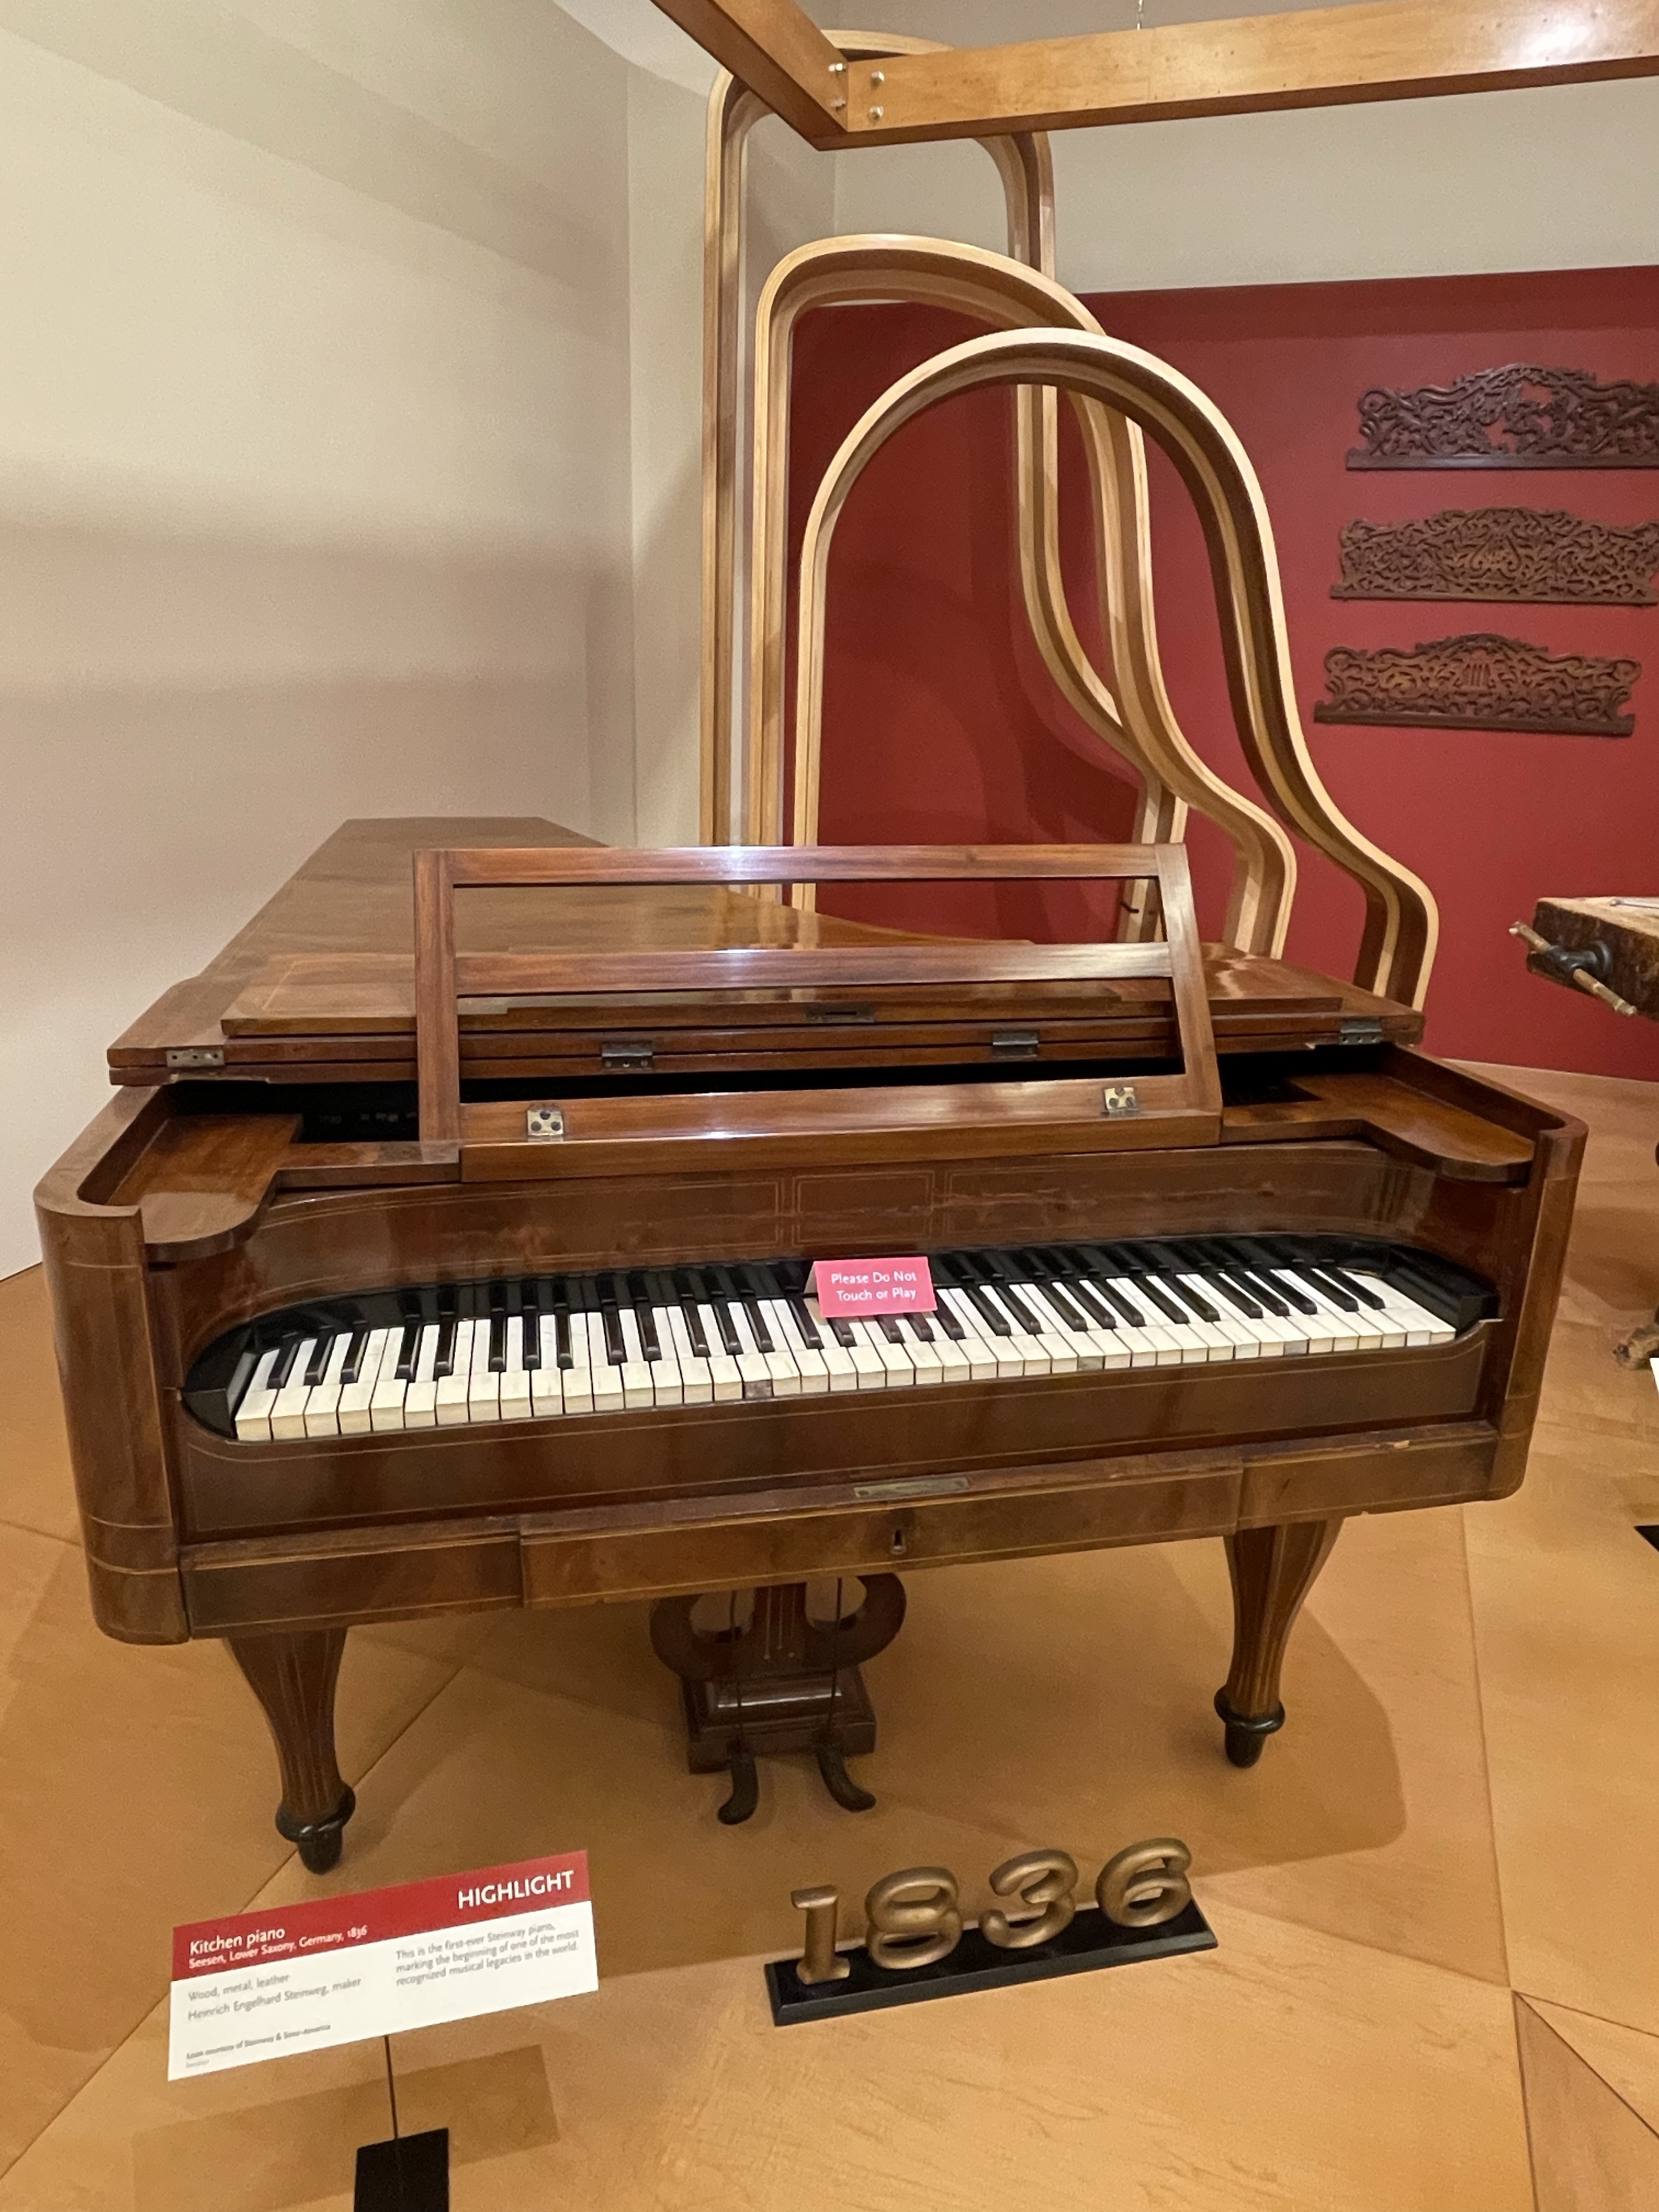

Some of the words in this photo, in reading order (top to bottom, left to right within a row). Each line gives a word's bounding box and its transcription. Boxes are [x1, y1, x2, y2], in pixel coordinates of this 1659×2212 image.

[831, 1273, 869, 1284] Please
[872, 1272, 890, 1283] Do
[893, 1271, 917, 1282] Not
[836, 1290, 872, 1301] Touch
[876, 1290, 888, 1300] or
[892, 1287, 916, 1300] Play
[458, 1870, 574, 1909] HIGHLIGHT
[791, 1837, 1192, 1985] 1836
[189, 1954, 227, 1970] Seesen,
[229, 1948, 259, 1962] Lower
[261, 1941, 297, 1955] Saxony,
[298, 1932, 345, 1948] Germany,
[347, 1925, 369, 1940] 1836
[190, 1935, 242, 1955] Kitchen
[247, 1928, 286, 1949] piano
[396, 1949, 415, 1960] This
[417, 1948, 426, 1956] is
[428, 1943, 443, 1954] the
[445, 1937, 485, 1950] first-ever
[487, 1929, 526, 1943] Steinway
[528, 1923, 556, 1936] piano,
[396, 1960, 433, 1973] marking
[436, 1954, 450, 1966] the
[452, 1946, 497, 1963] beginning
[499, 1941, 509, 1953] of
[510, 1941, 527, 1951] one
[529, 1934, 539, 1946] of
[540, 1934, 554, 1944] the
[556, 1929, 579, 1941] most
[396, 1967, 447, 1986] recognized
[449, 1959, 484, 1974] musical
[486, 1954, 522, 1970] legacies
[524, 1951, 533, 1960] in
[535, 1947, 550, 1958] the
[552, 1940, 579, 1955] world.
[188, 1987, 221, 2002] Wood,
[223, 1979, 254, 1995] metal,
[256, 1974, 290, 1988] leather
[188, 2003, 230, 2021] Heinrich
[233, 1992, 281, 2012] Engelhard
[332, 1978, 362, 1991] maker
